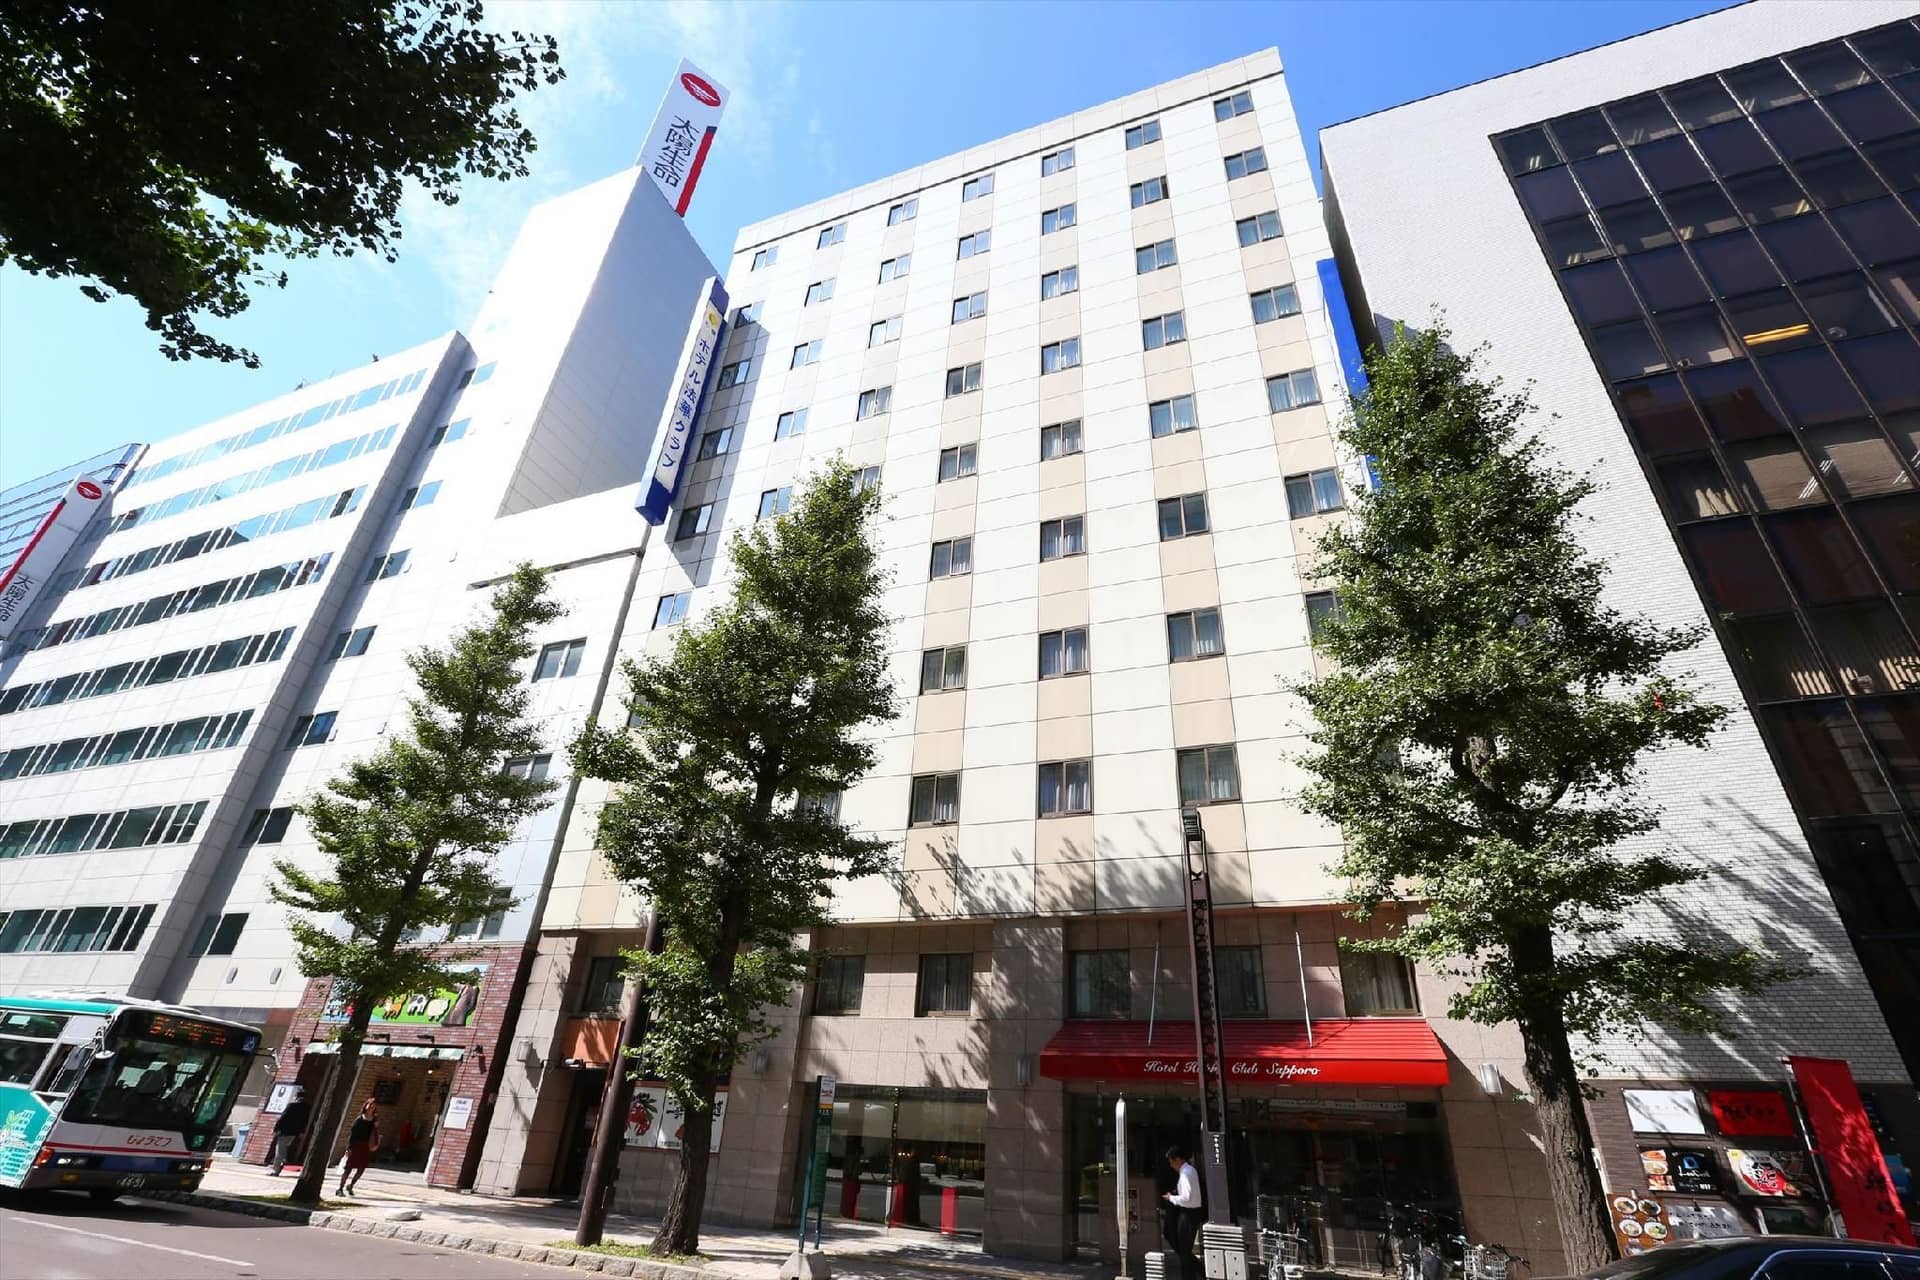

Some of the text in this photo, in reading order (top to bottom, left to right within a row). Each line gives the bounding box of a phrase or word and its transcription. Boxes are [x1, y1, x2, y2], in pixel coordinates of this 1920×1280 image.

[653, 115, 700, 188] 太陽生命
[1143, 1060, 1179, 1073] Hotel
[1231, 1062, 1259, 1074] Club
[1265, 1062, 1321, 1079] Sapporo
